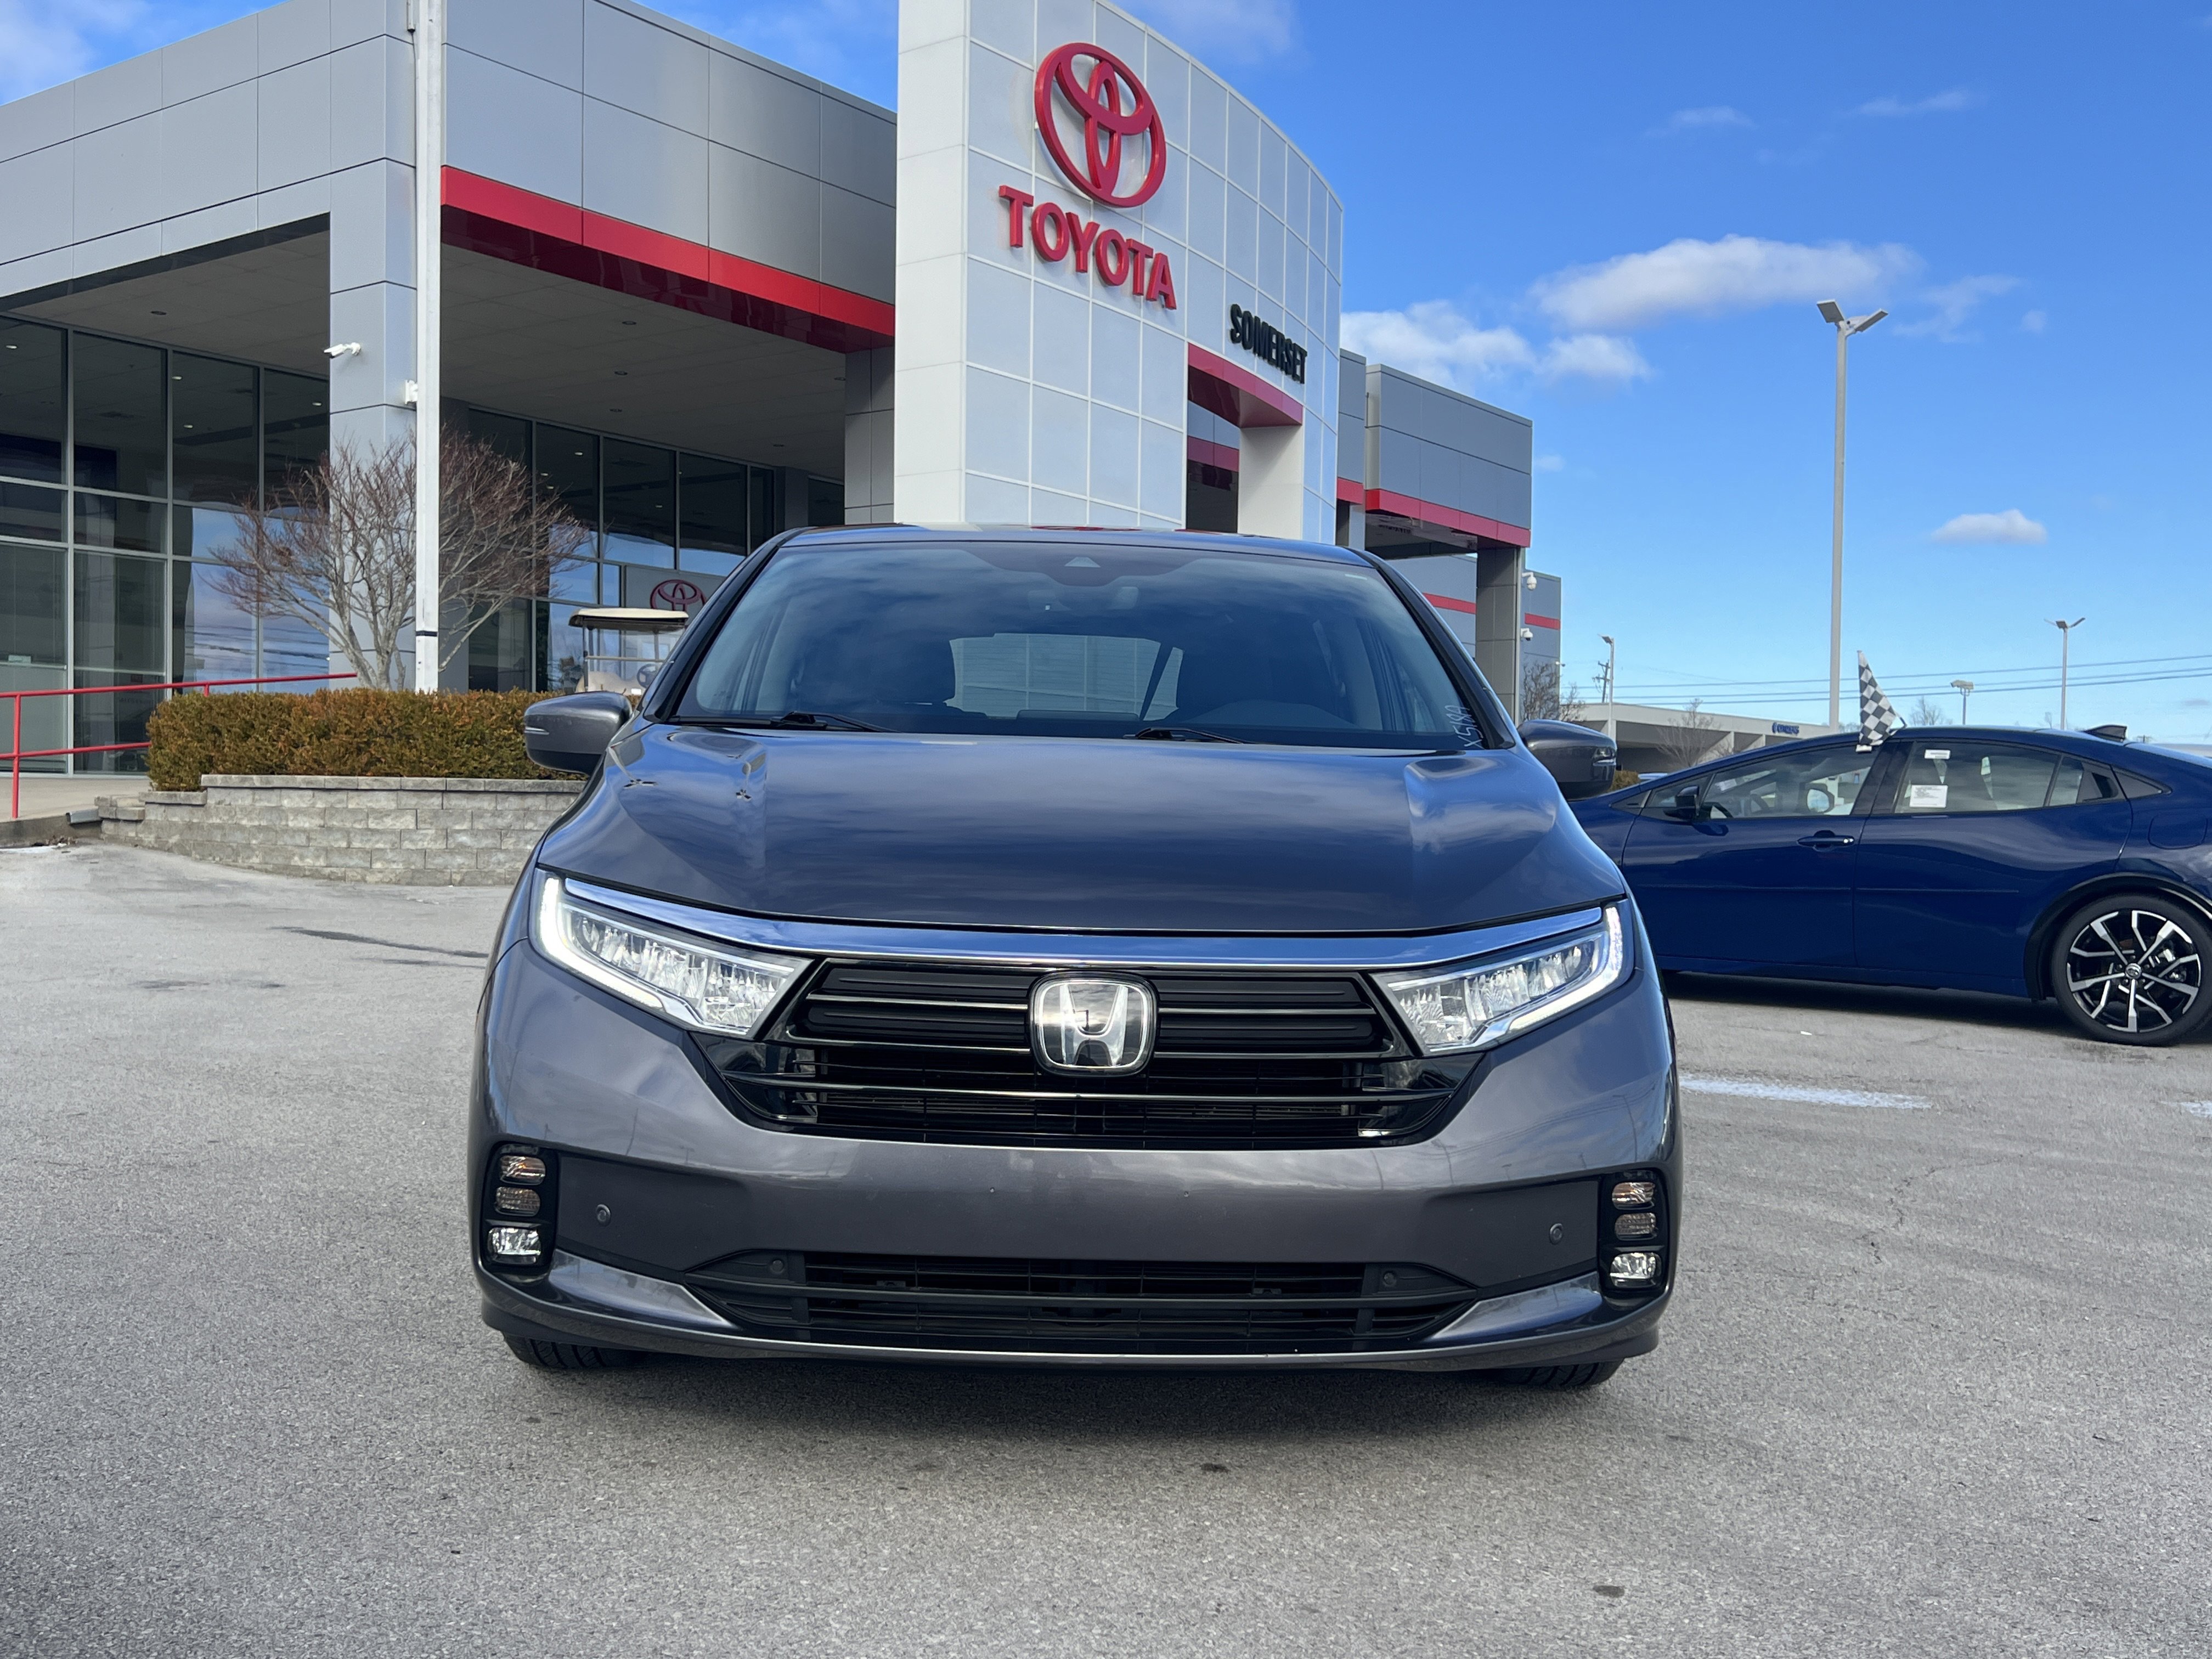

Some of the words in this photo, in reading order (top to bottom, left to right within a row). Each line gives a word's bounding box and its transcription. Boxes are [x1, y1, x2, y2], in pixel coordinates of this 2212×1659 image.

[998, 185, 1177, 310] TOYOTA
[1230, 304, 1308, 384] SOMERSET
[1444, 705, 1485, 750] X518A
